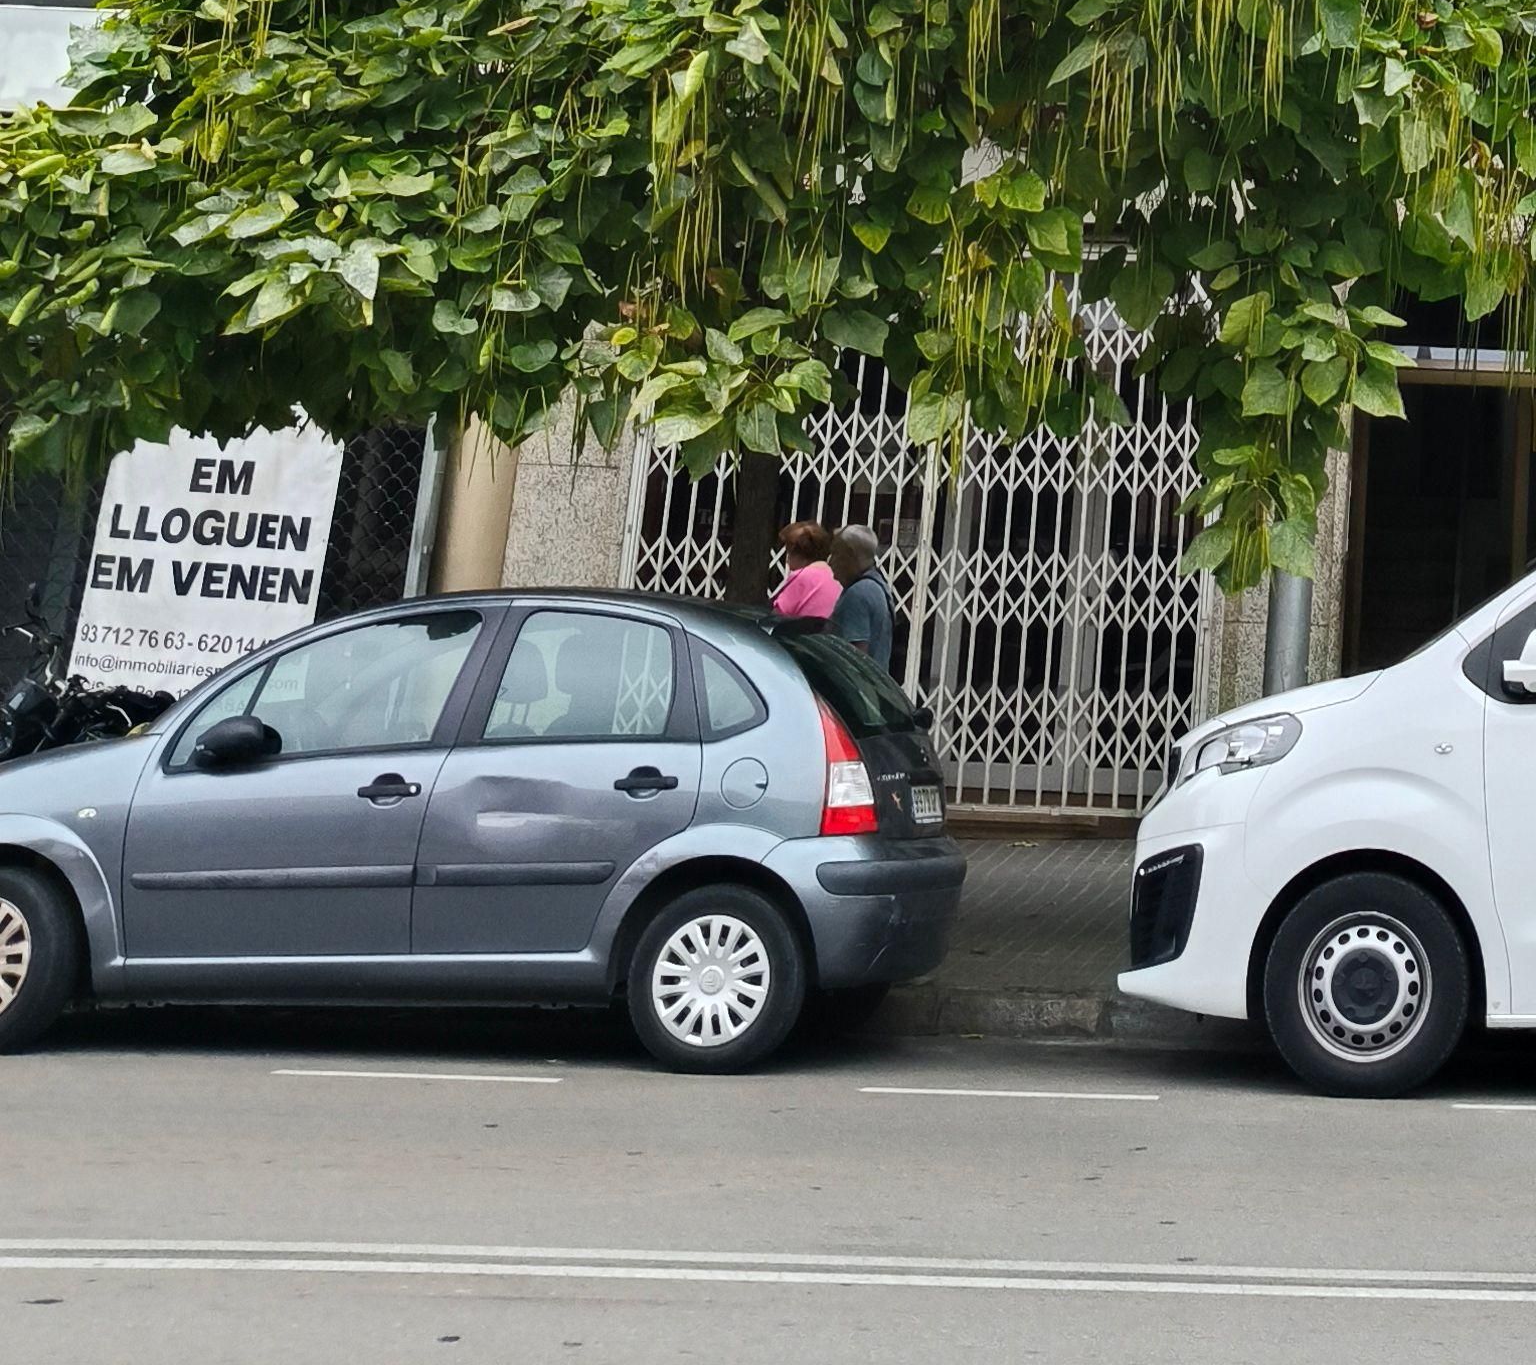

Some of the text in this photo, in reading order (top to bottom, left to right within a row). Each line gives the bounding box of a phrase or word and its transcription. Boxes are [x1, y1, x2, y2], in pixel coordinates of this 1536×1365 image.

[189, 458, 256, 496] EM
[109, 503, 312, 551] LLOGUEN
[90, 554, 314, 604] EM VENEN
[81, 623, 98, 643] 93
[101, 626, 133, 646] 712
[138, 629, 159, 648] 76
